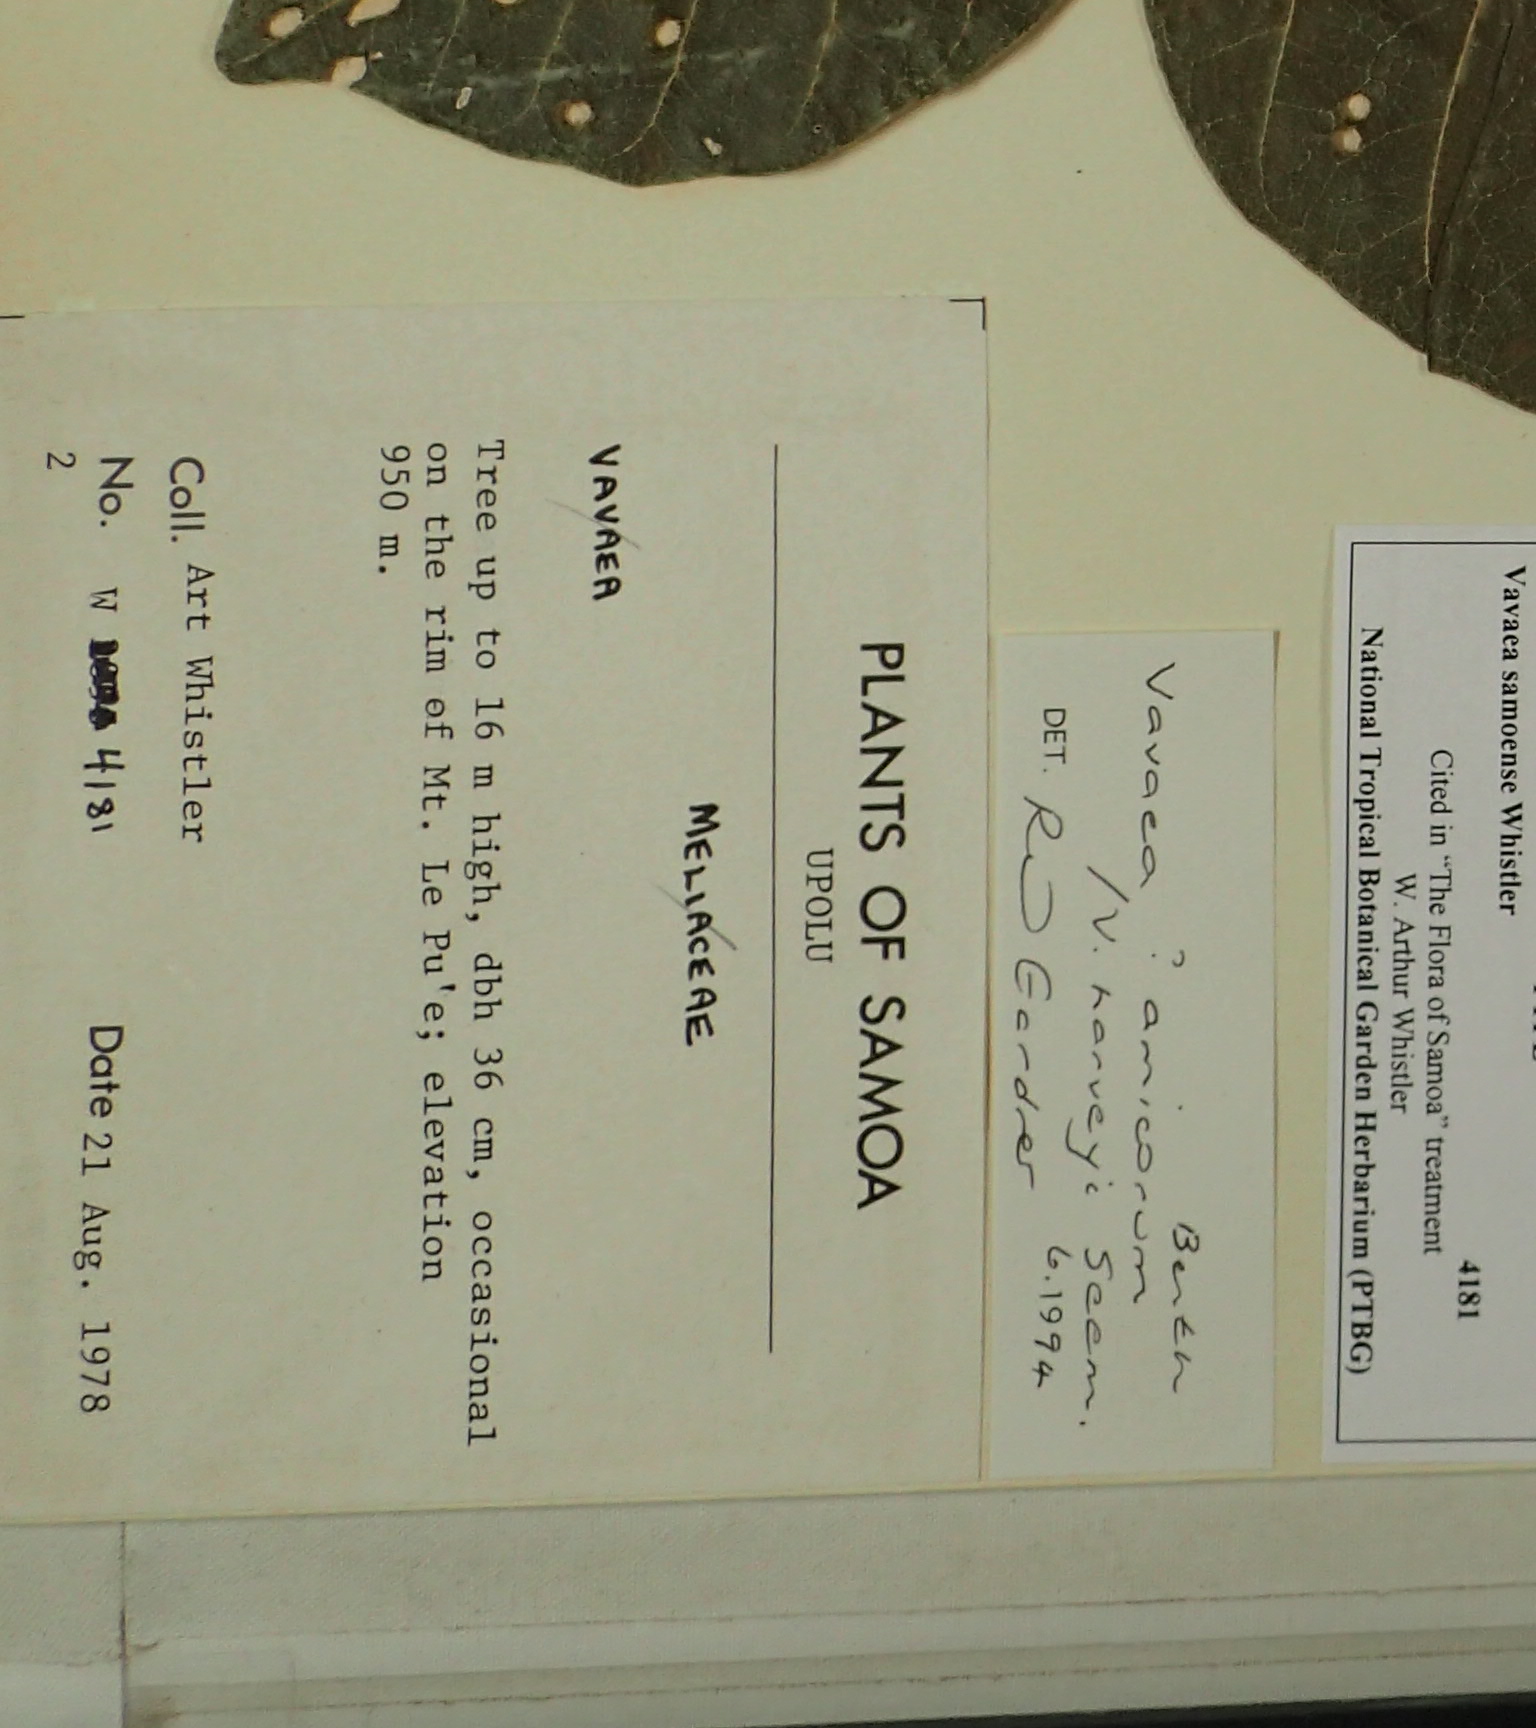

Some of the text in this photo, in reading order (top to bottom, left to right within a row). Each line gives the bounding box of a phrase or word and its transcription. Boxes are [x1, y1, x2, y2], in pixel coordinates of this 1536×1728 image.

[47, 452, 76, 469] 2
[99, 457, 135, 527] No.
[379, 445, 411, 573] 950 m.
[90, 587, 118, 612] W
[170, 457, 215, 843] Coll. Art Whistler
[84, 749, 125, 832] 4181
[1044, 709, 1066, 772] DET.
[1500, 566, 1526, 915] Vavaea samoense Whistler
[416, 443, 456, 1281] on the rim of Mt. Le Pu'e; elevation
[464, 439, 505, 1446] Tree up to 16 m high, dbh 36 cm, occasional
[682, 803, 723, 1047] MELIACEAE
[805, 848, 834, 963] UPOLU
[857, 643, 907, 1210] PLANTS OF SAMOA
[1346, 628, 1383, 1374] National Tropical Botanical Garden Herbarium (PTBG)
[1391, 874, 1416, 1114] W. Arthur Whistler
[1423, 750, 1453, 1254] Cited in “The Flora of Samoa” treatment
[73, 1026, 124, 1412] Date 21 Aug. 1978
[1458, 1260, 1481, 1318] 4181
